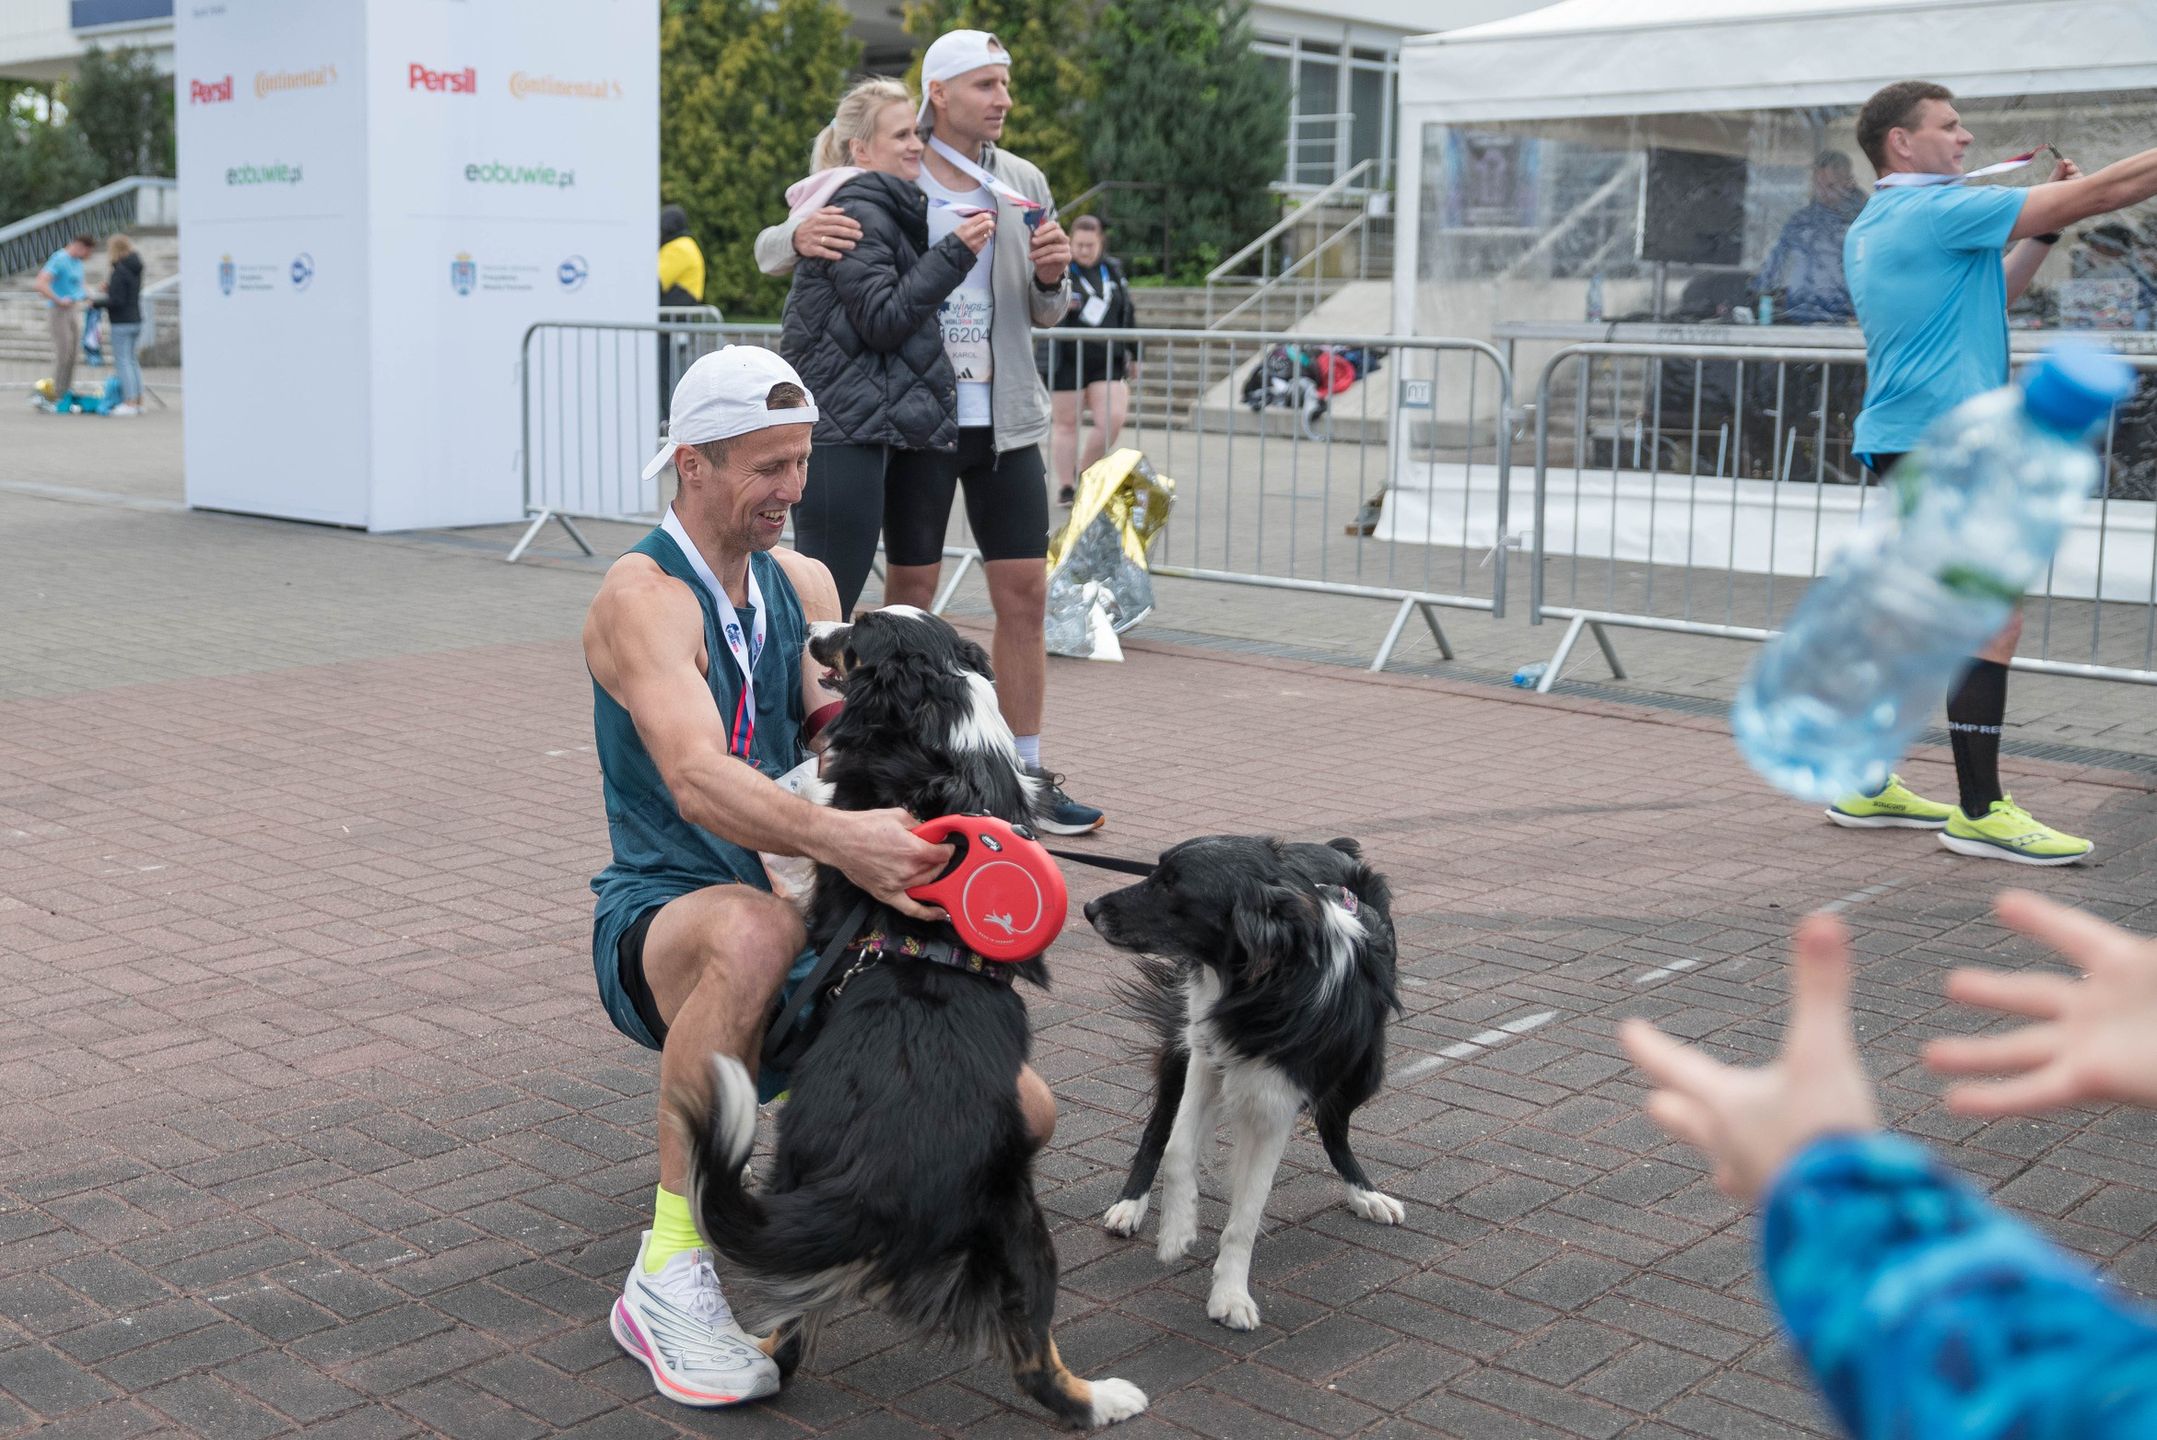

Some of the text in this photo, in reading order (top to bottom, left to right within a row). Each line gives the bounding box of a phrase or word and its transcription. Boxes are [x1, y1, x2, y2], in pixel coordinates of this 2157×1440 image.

[191, 75, 233, 104] Persil
[409, 62, 476, 94] Persil
[509, 71, 608, 100] Continental
[465, 160, 575, 188] eobuwie.pl
